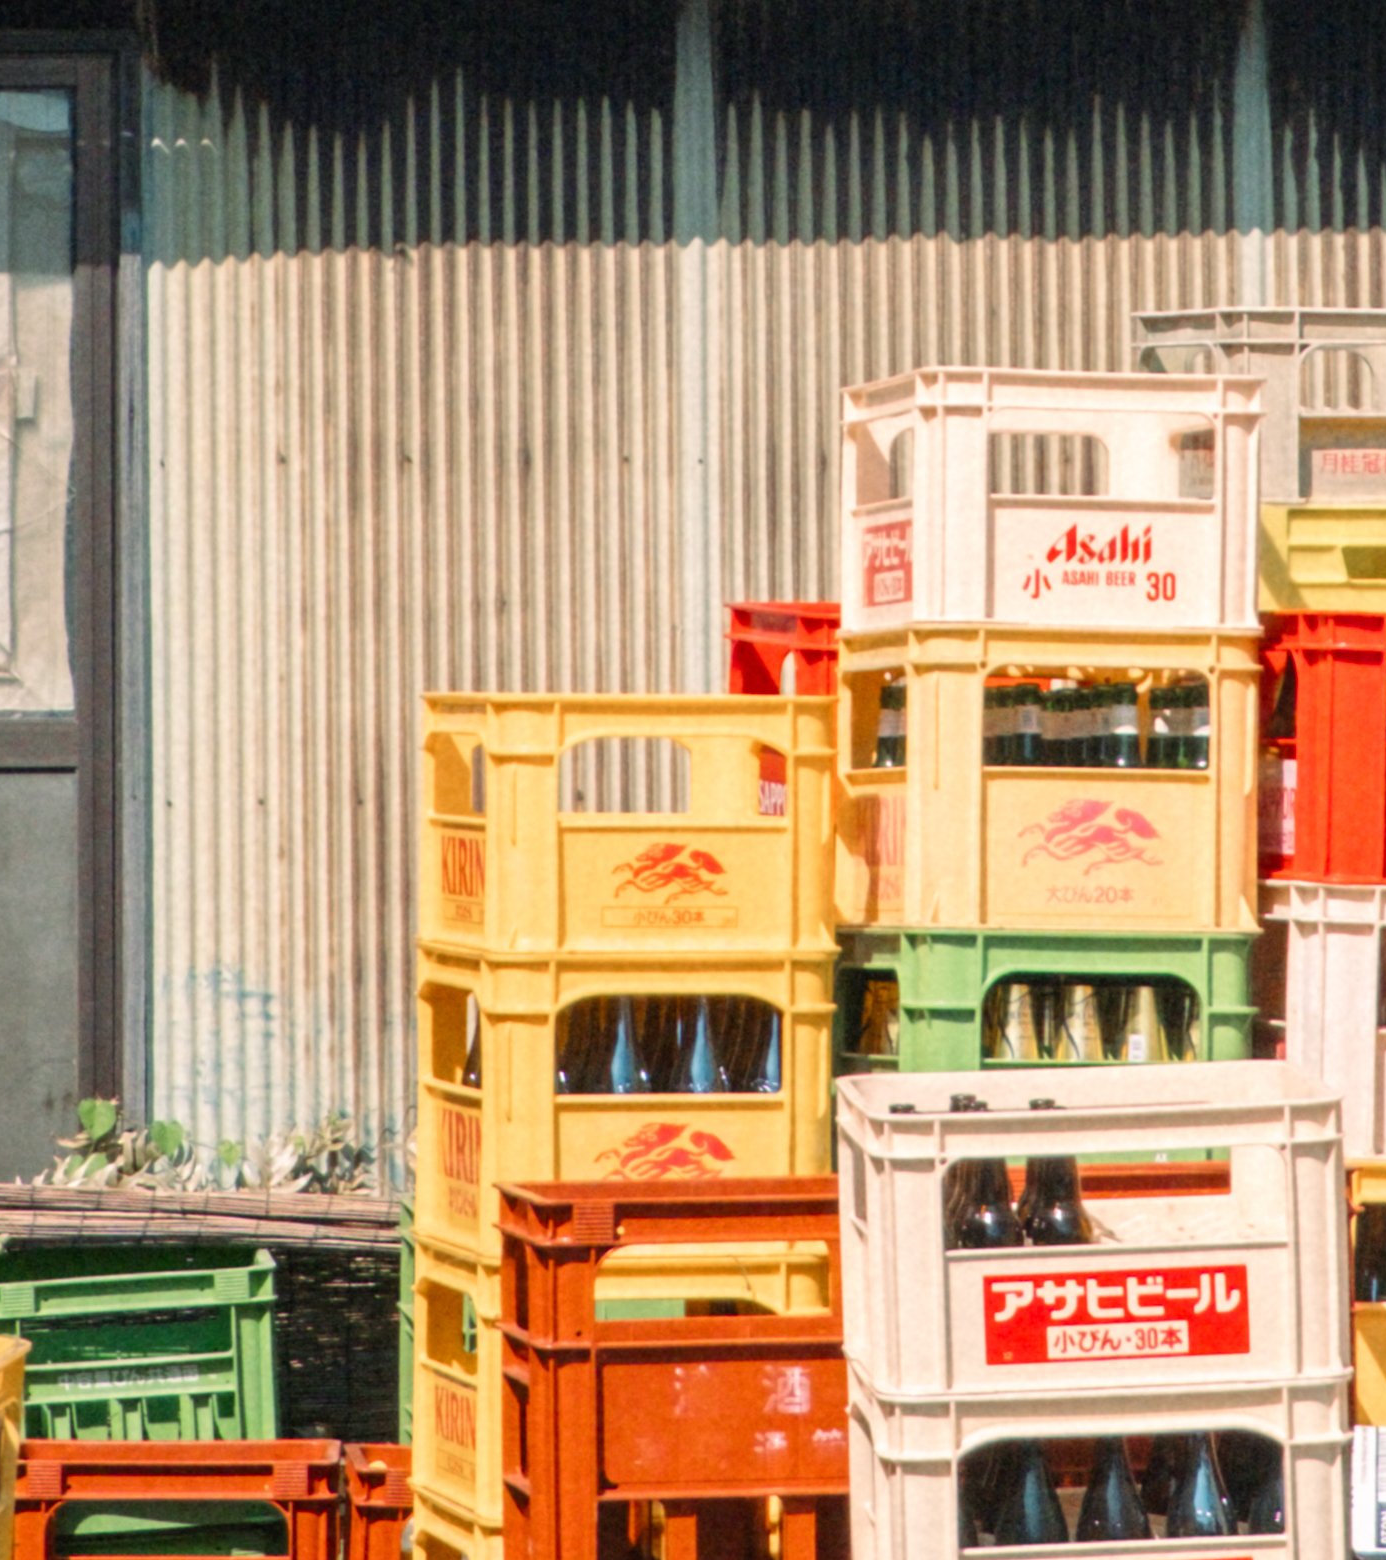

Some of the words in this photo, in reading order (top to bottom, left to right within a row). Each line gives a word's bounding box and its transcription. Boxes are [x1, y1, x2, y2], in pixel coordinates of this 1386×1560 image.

[1046, 523, 1152, 564] Asahi
[1022, 568, 1052, 599] 小
[1062, 570, 1099, 586] ASAHI
[1106, 571, 1136, 586] BEER
[1146, 572, 1176, 601] 30
[991, 1272, 1241, 1322] アサヒビール
[1054, 1326, 1182, 1354] 小びん・30本
